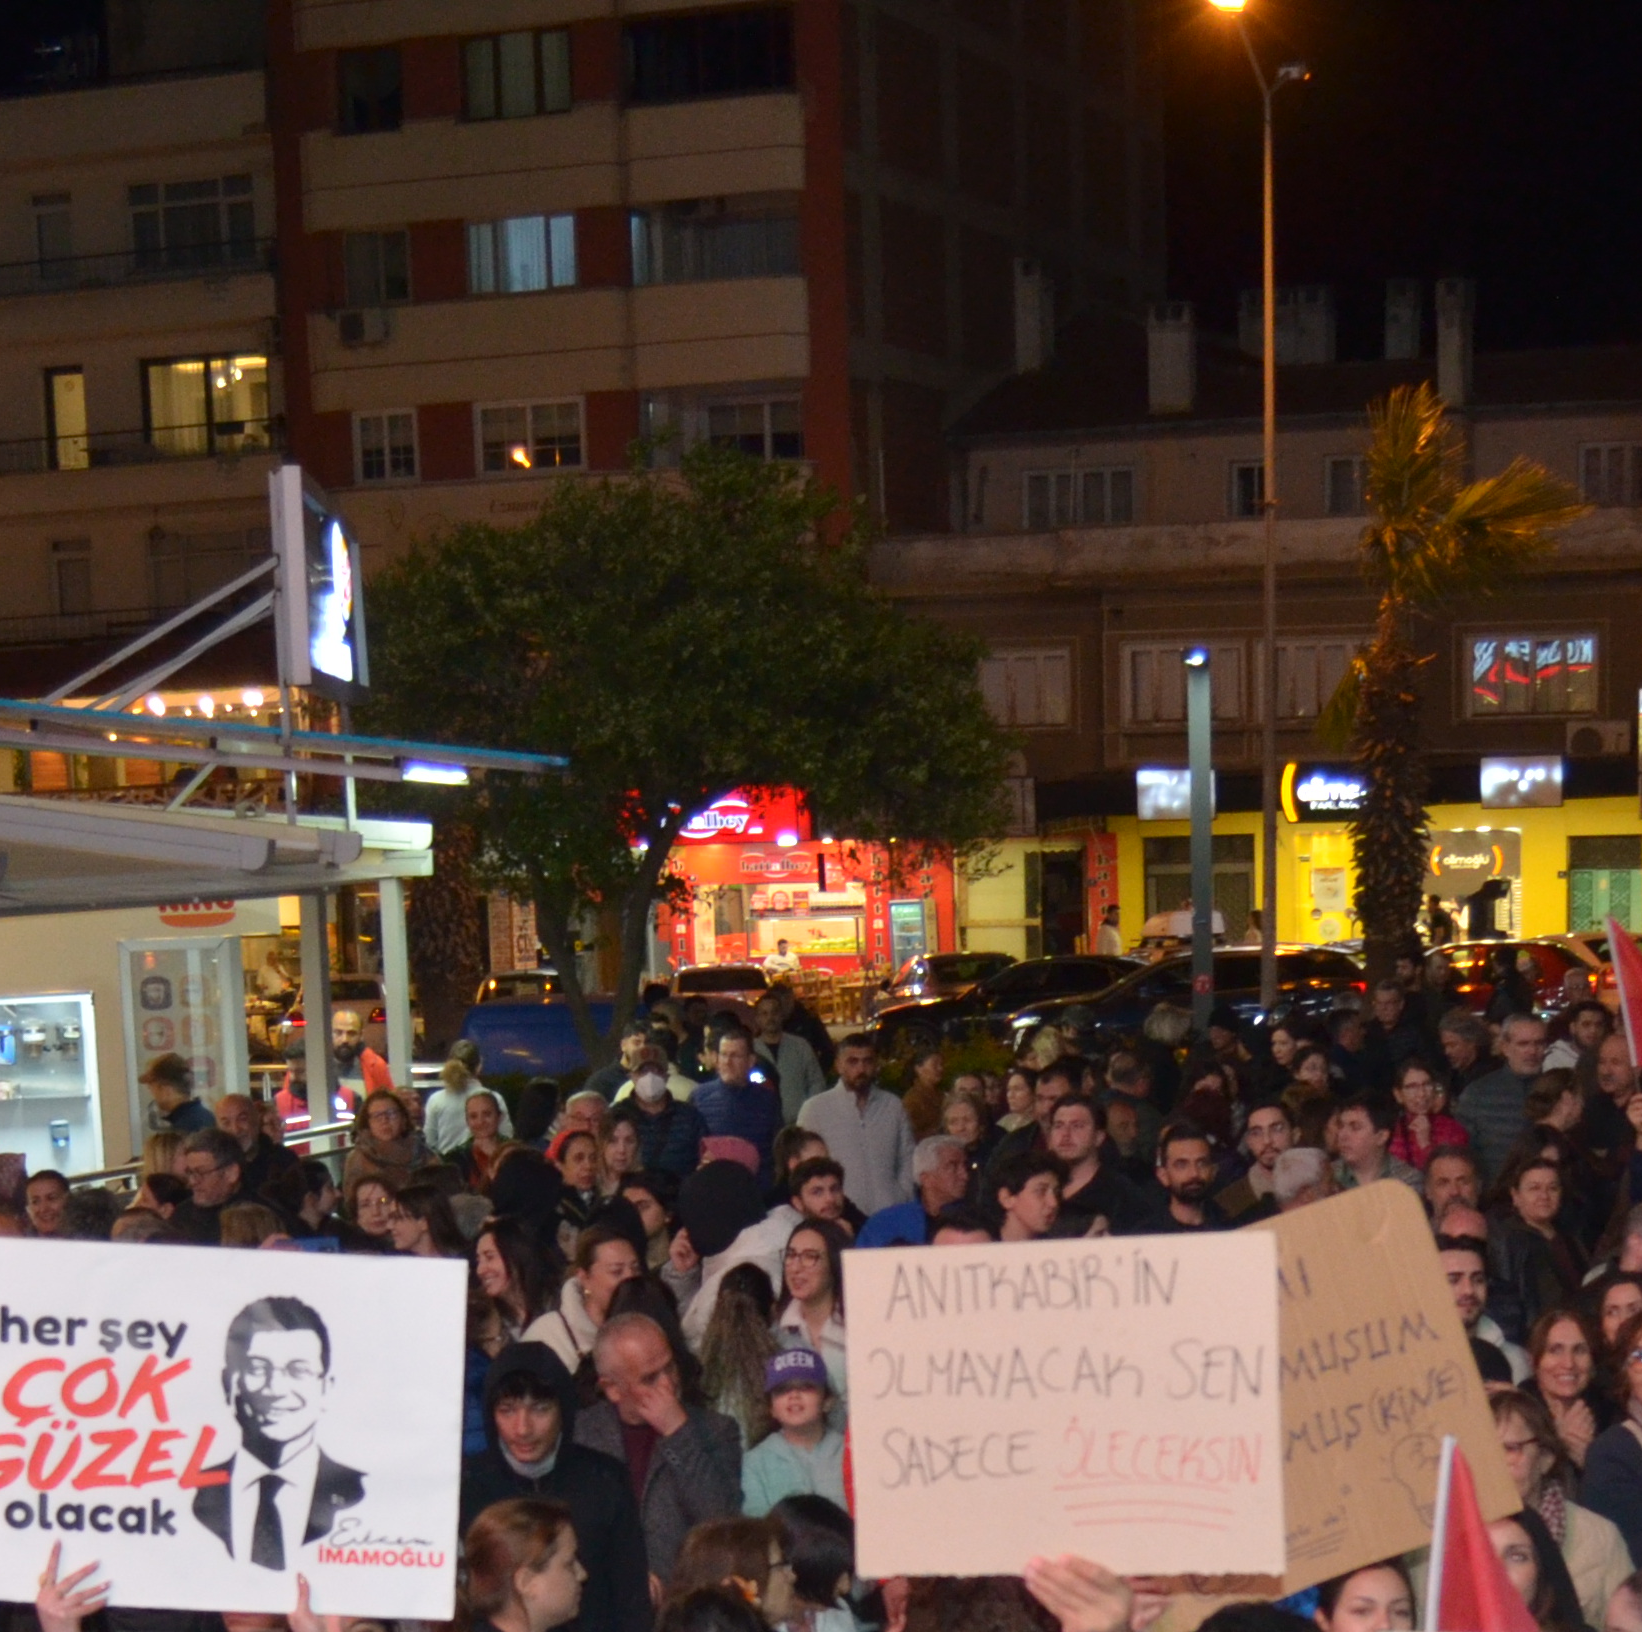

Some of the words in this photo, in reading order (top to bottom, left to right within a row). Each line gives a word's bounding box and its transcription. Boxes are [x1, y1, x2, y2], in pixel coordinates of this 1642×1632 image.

[0, 1305, 87, 1348] her
[98, 1319, 188, 1359] şey
[1, 1354, 192, 1427] ÇOK
[868, 1345, 1144, 1402] OLMAYACAK
[1166, 1337, 1265, 1404] SEN
[880, 1426, 1037, 1492] SADECE
[4, 1493, 178, 1537] olacak
[318, 1546, 446, 1570] İMAMOĞLU
